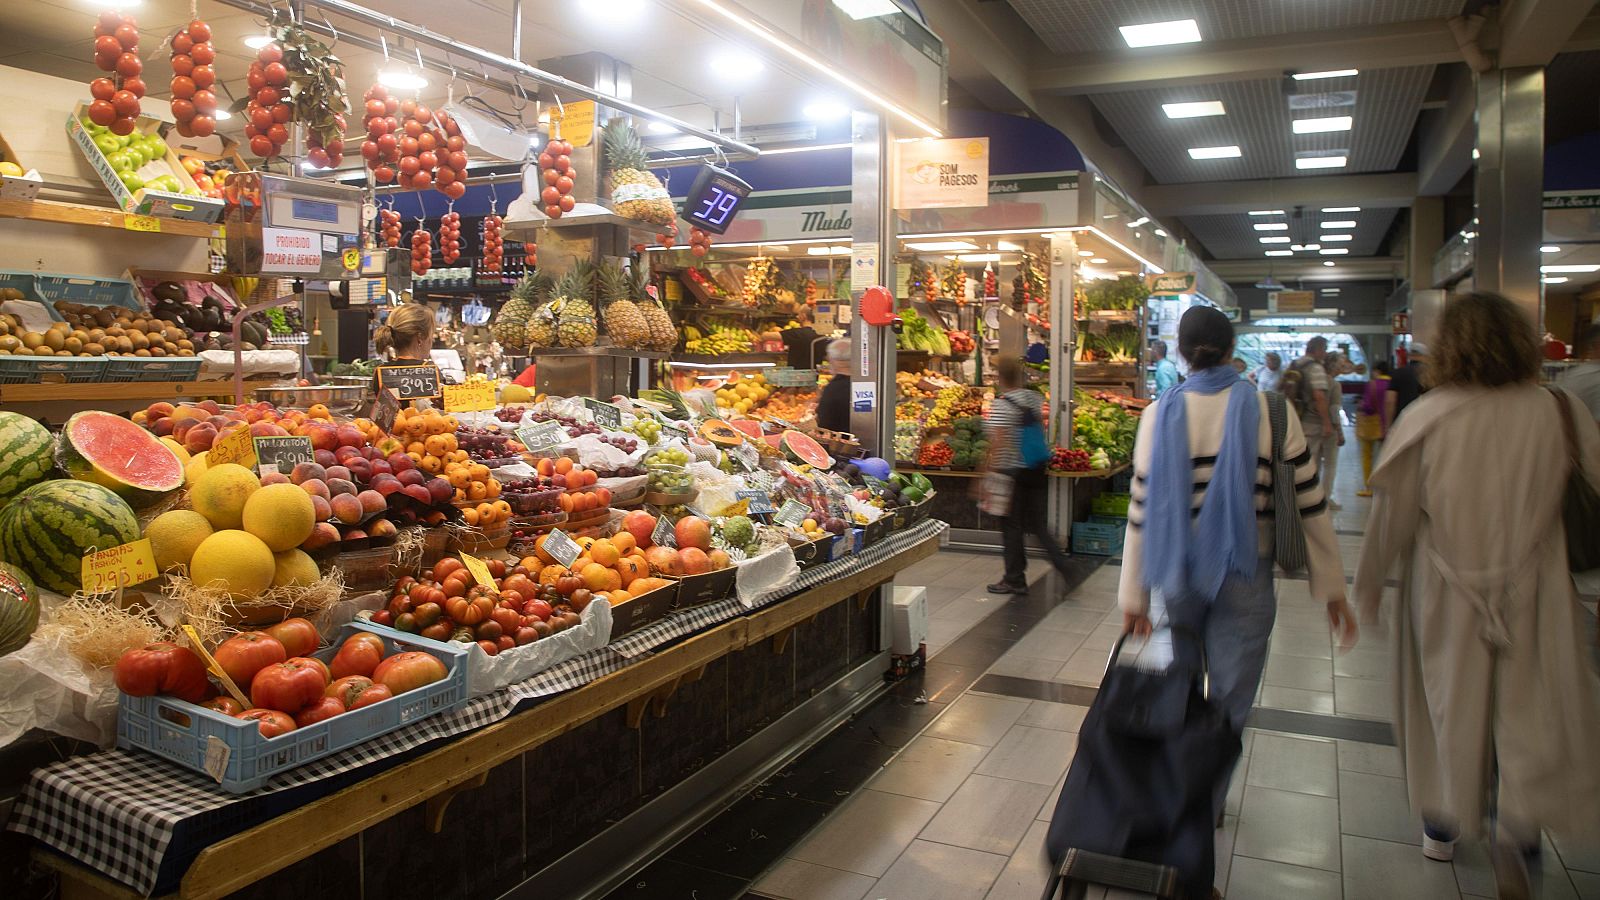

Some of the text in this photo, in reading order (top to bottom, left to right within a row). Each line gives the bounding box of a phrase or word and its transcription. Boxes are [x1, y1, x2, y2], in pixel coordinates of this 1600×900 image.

[940, 164, 958, 175] SOM
[940, 174, 978, 186] PAGESOS
[693, 186, 738, 225] 39
[275, 235, 310, 249] PROHIBIDO
[265, 252, 286, 265] TOCAR
[287, 255, 294, 265] EL
[400, 377, 434, 395] 3'95
[855, 391, 874, 399] VISA
